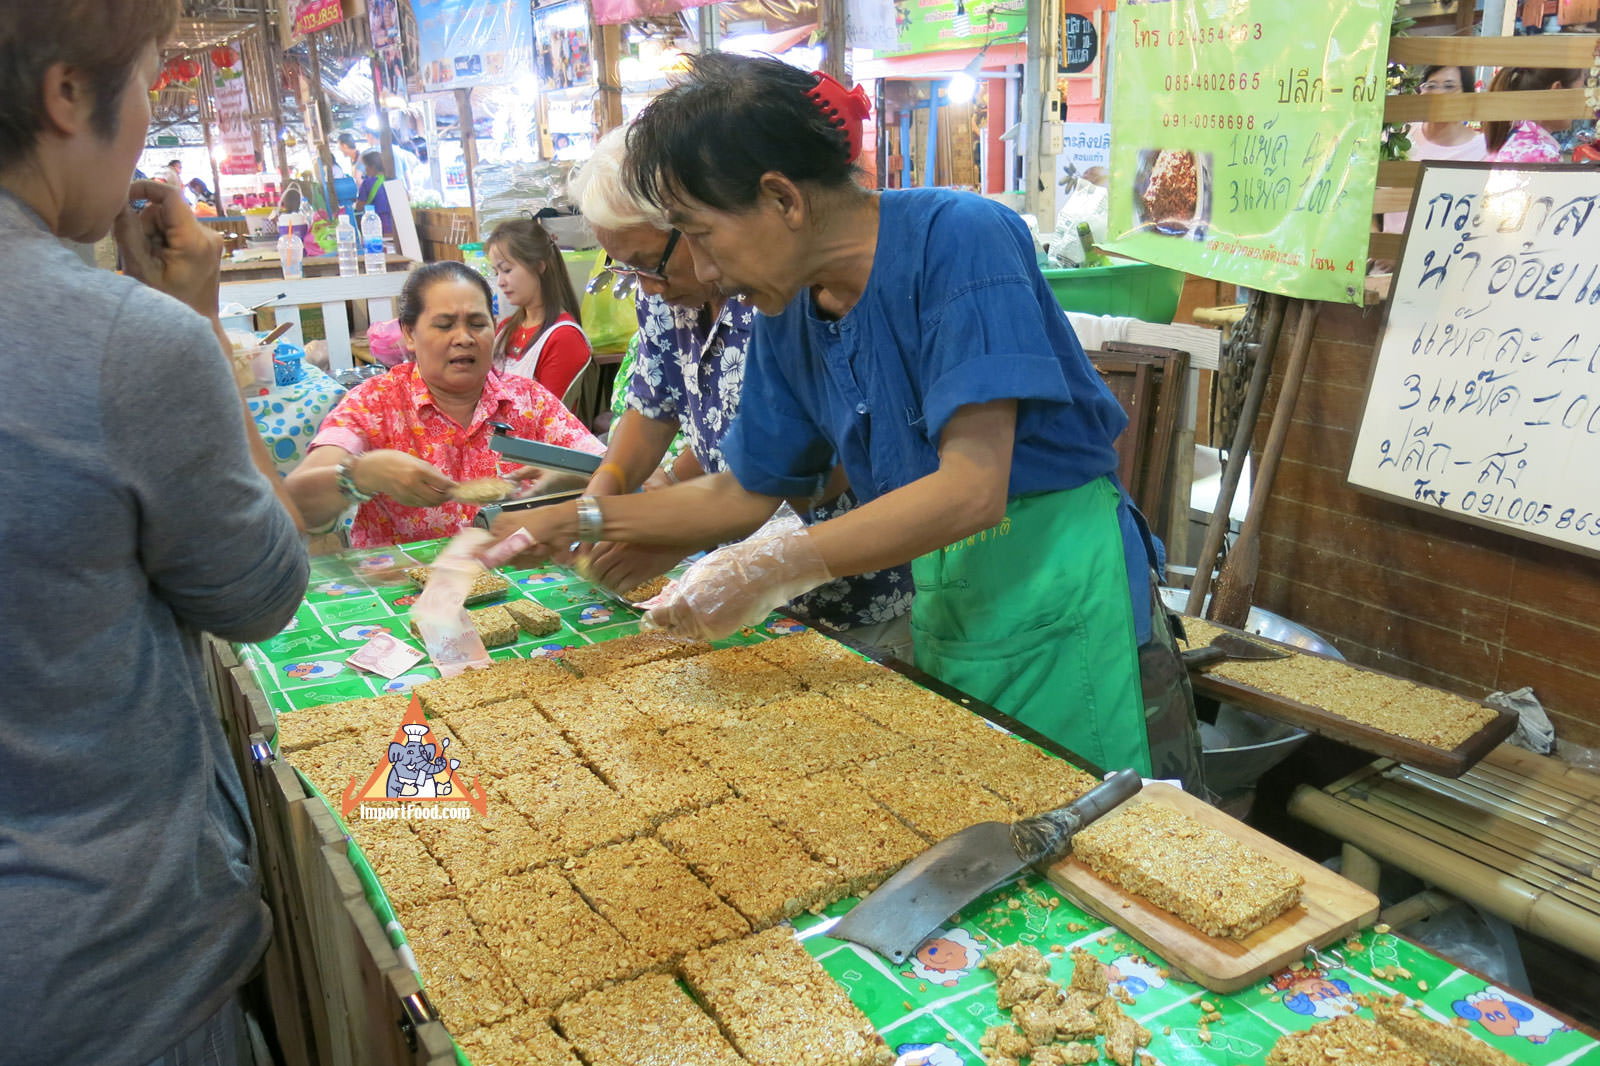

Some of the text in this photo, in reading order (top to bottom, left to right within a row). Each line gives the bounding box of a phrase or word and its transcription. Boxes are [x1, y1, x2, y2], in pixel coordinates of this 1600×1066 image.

[1132, 19, 1160, 48] โทร
[1163, 113, 1255, 130] 091-0058698
[1425, 192, 1600, 238] กระยาส
[1310, 249, 1336, 272] โซน
[1345, 260, 1355, 273] 4
